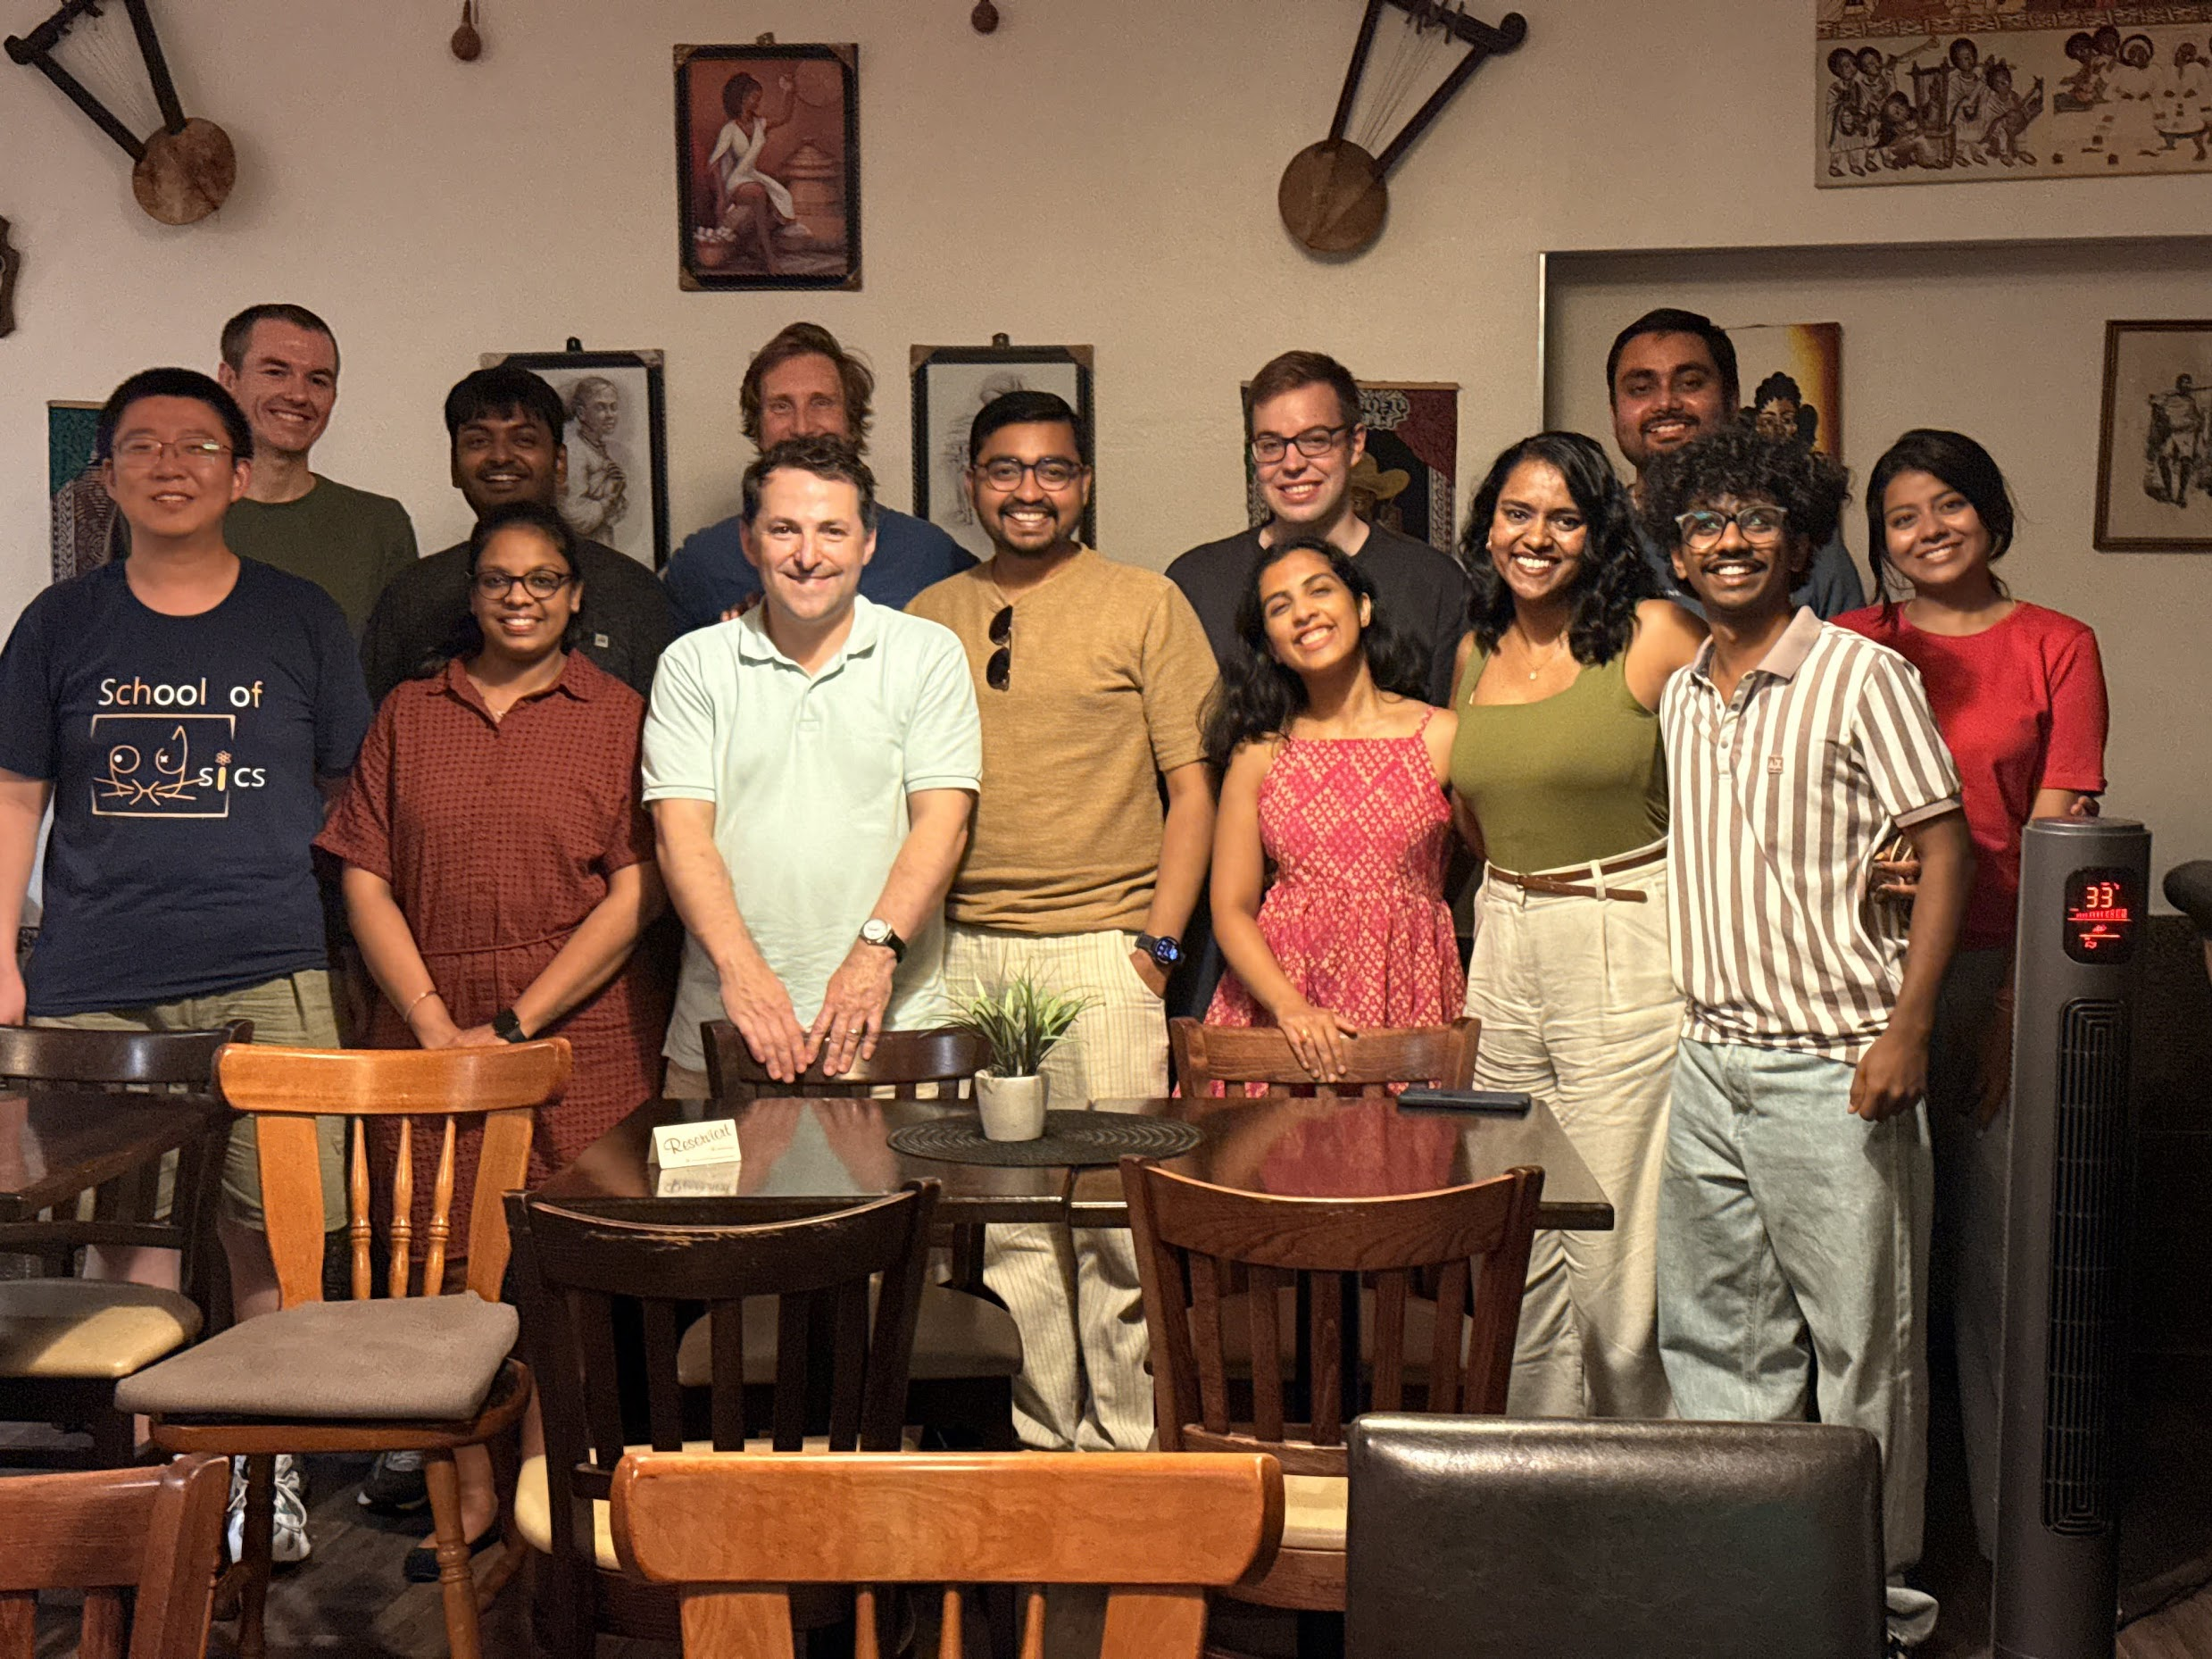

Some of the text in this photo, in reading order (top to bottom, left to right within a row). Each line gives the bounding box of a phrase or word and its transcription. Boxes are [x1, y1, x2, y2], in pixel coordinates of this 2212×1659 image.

[98, 676, 263, 708] School of
[2086, 886, 2113, 908] 33
